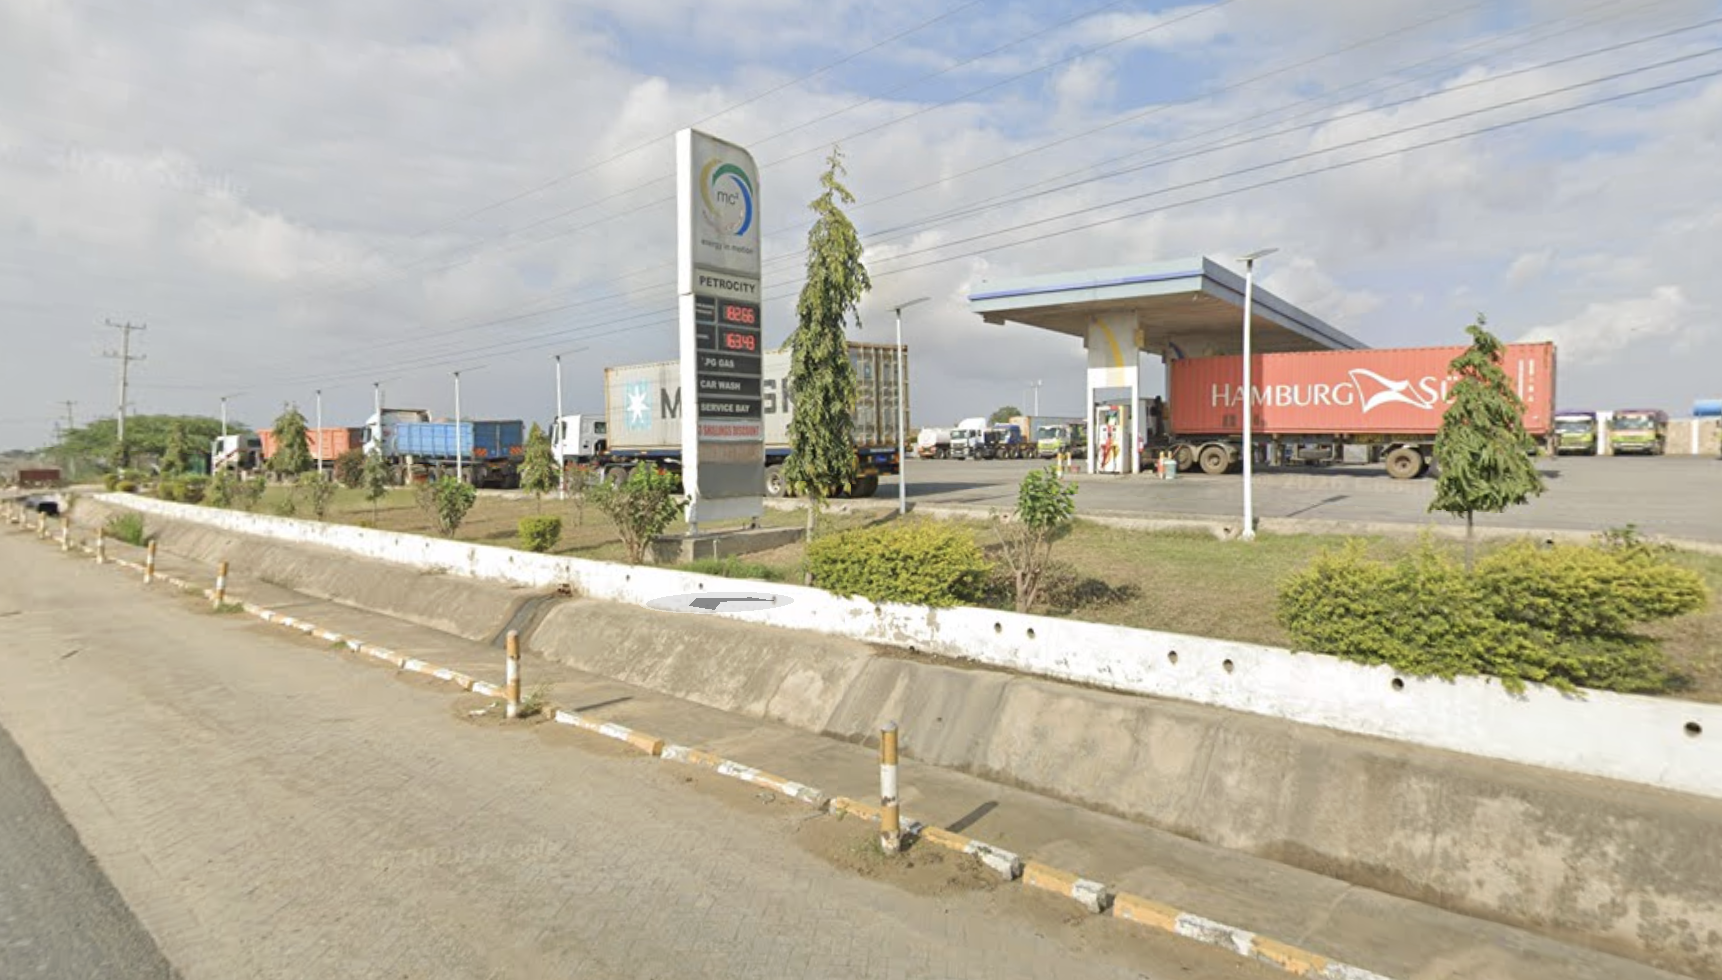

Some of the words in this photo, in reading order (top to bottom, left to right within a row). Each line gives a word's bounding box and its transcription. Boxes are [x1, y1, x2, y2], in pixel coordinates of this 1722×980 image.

[699, 275, 755, 293] PETROCITY
[718, 359, 735, 368] GAS
[700, 380, 717, 389] CAR
[718, 381, 741, 391] WASH
[1211, 382, 1354, 407] HAMBURG
[701, 403, 734, 413] SERVICE
[735, 404, 751, 413] BAY
